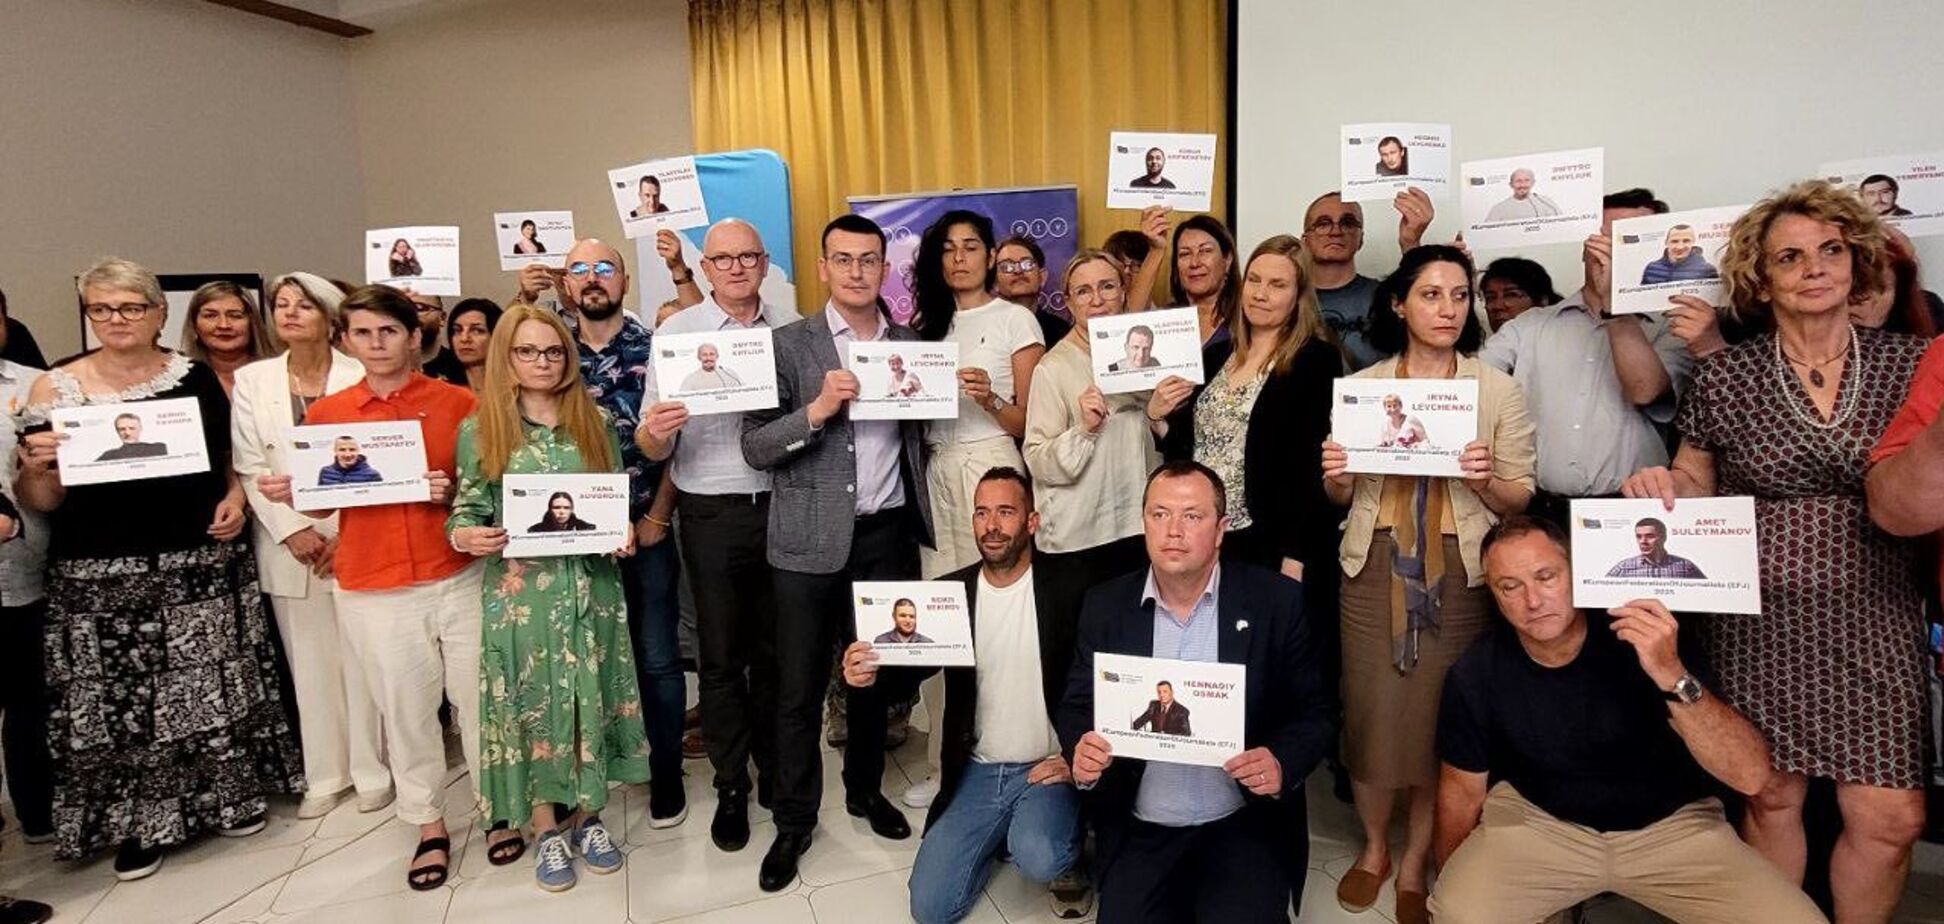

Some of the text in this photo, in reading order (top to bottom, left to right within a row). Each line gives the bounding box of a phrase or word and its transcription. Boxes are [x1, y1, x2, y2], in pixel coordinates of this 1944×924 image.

[1427, 393, 1459, 401] IRYNA
[1411, 403, 1473, 412] LEVCHENKO
[1695, 518, 1727, 526] AMET
[1671, 528, 1752, 536] SULEYMANOV
[1183, 680, 1236, 691] HENNADIY
[1192, 690, 1229, 700] OSMAK
